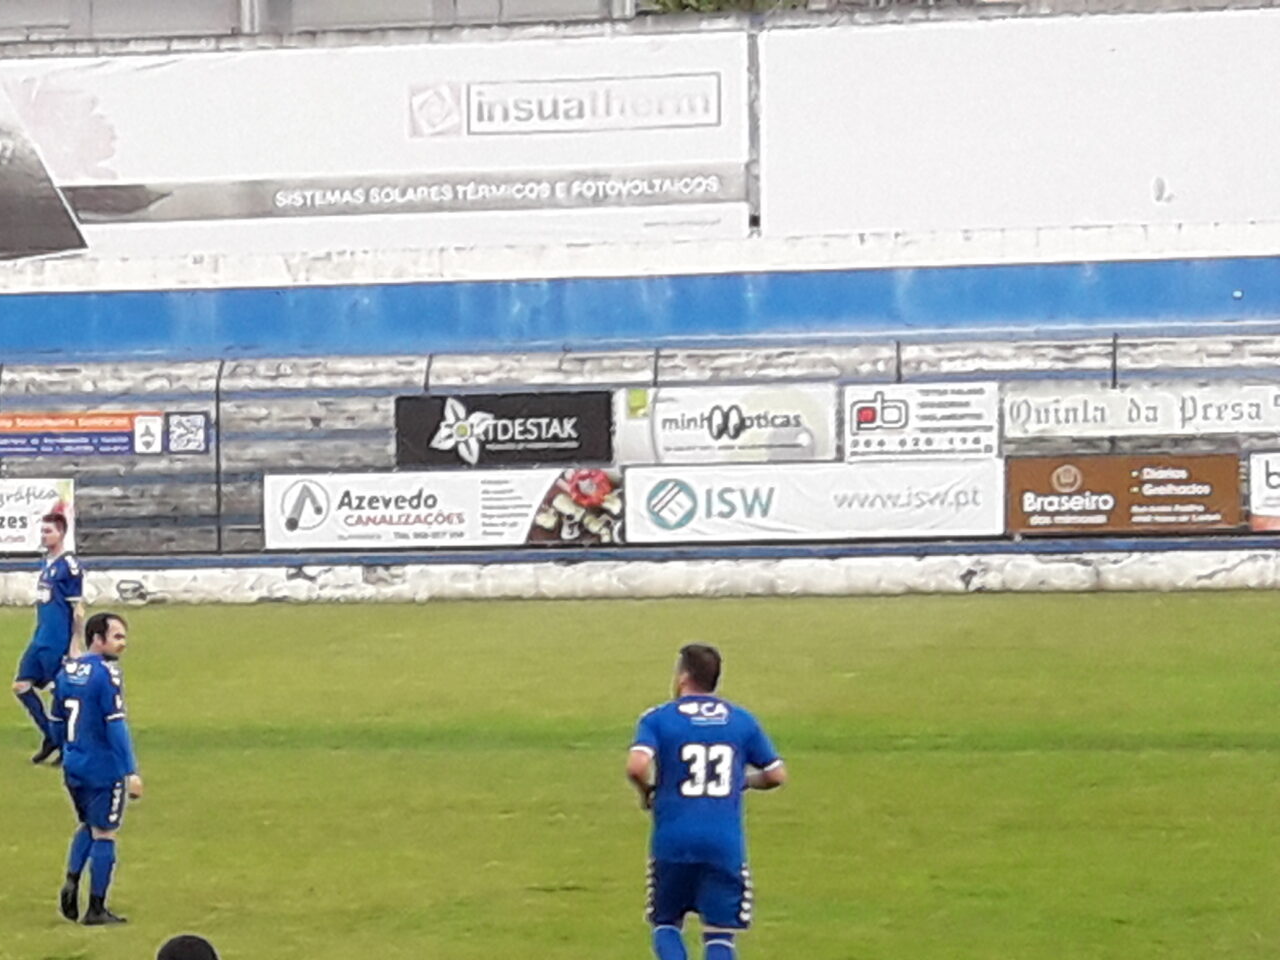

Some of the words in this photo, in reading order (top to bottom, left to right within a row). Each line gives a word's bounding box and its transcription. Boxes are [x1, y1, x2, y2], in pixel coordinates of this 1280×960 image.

[276, 188, 365, 208] SISTEMAS
[1128, 398, 1159, 424] da
[336, 487, 439, 511] Azevedo
[704, 487, 776, 520] ISW
[1022, 490, 1115, 513] Braseiro
[64, 699, 81, 742] 7
[680, 743, 734, 798] 33
